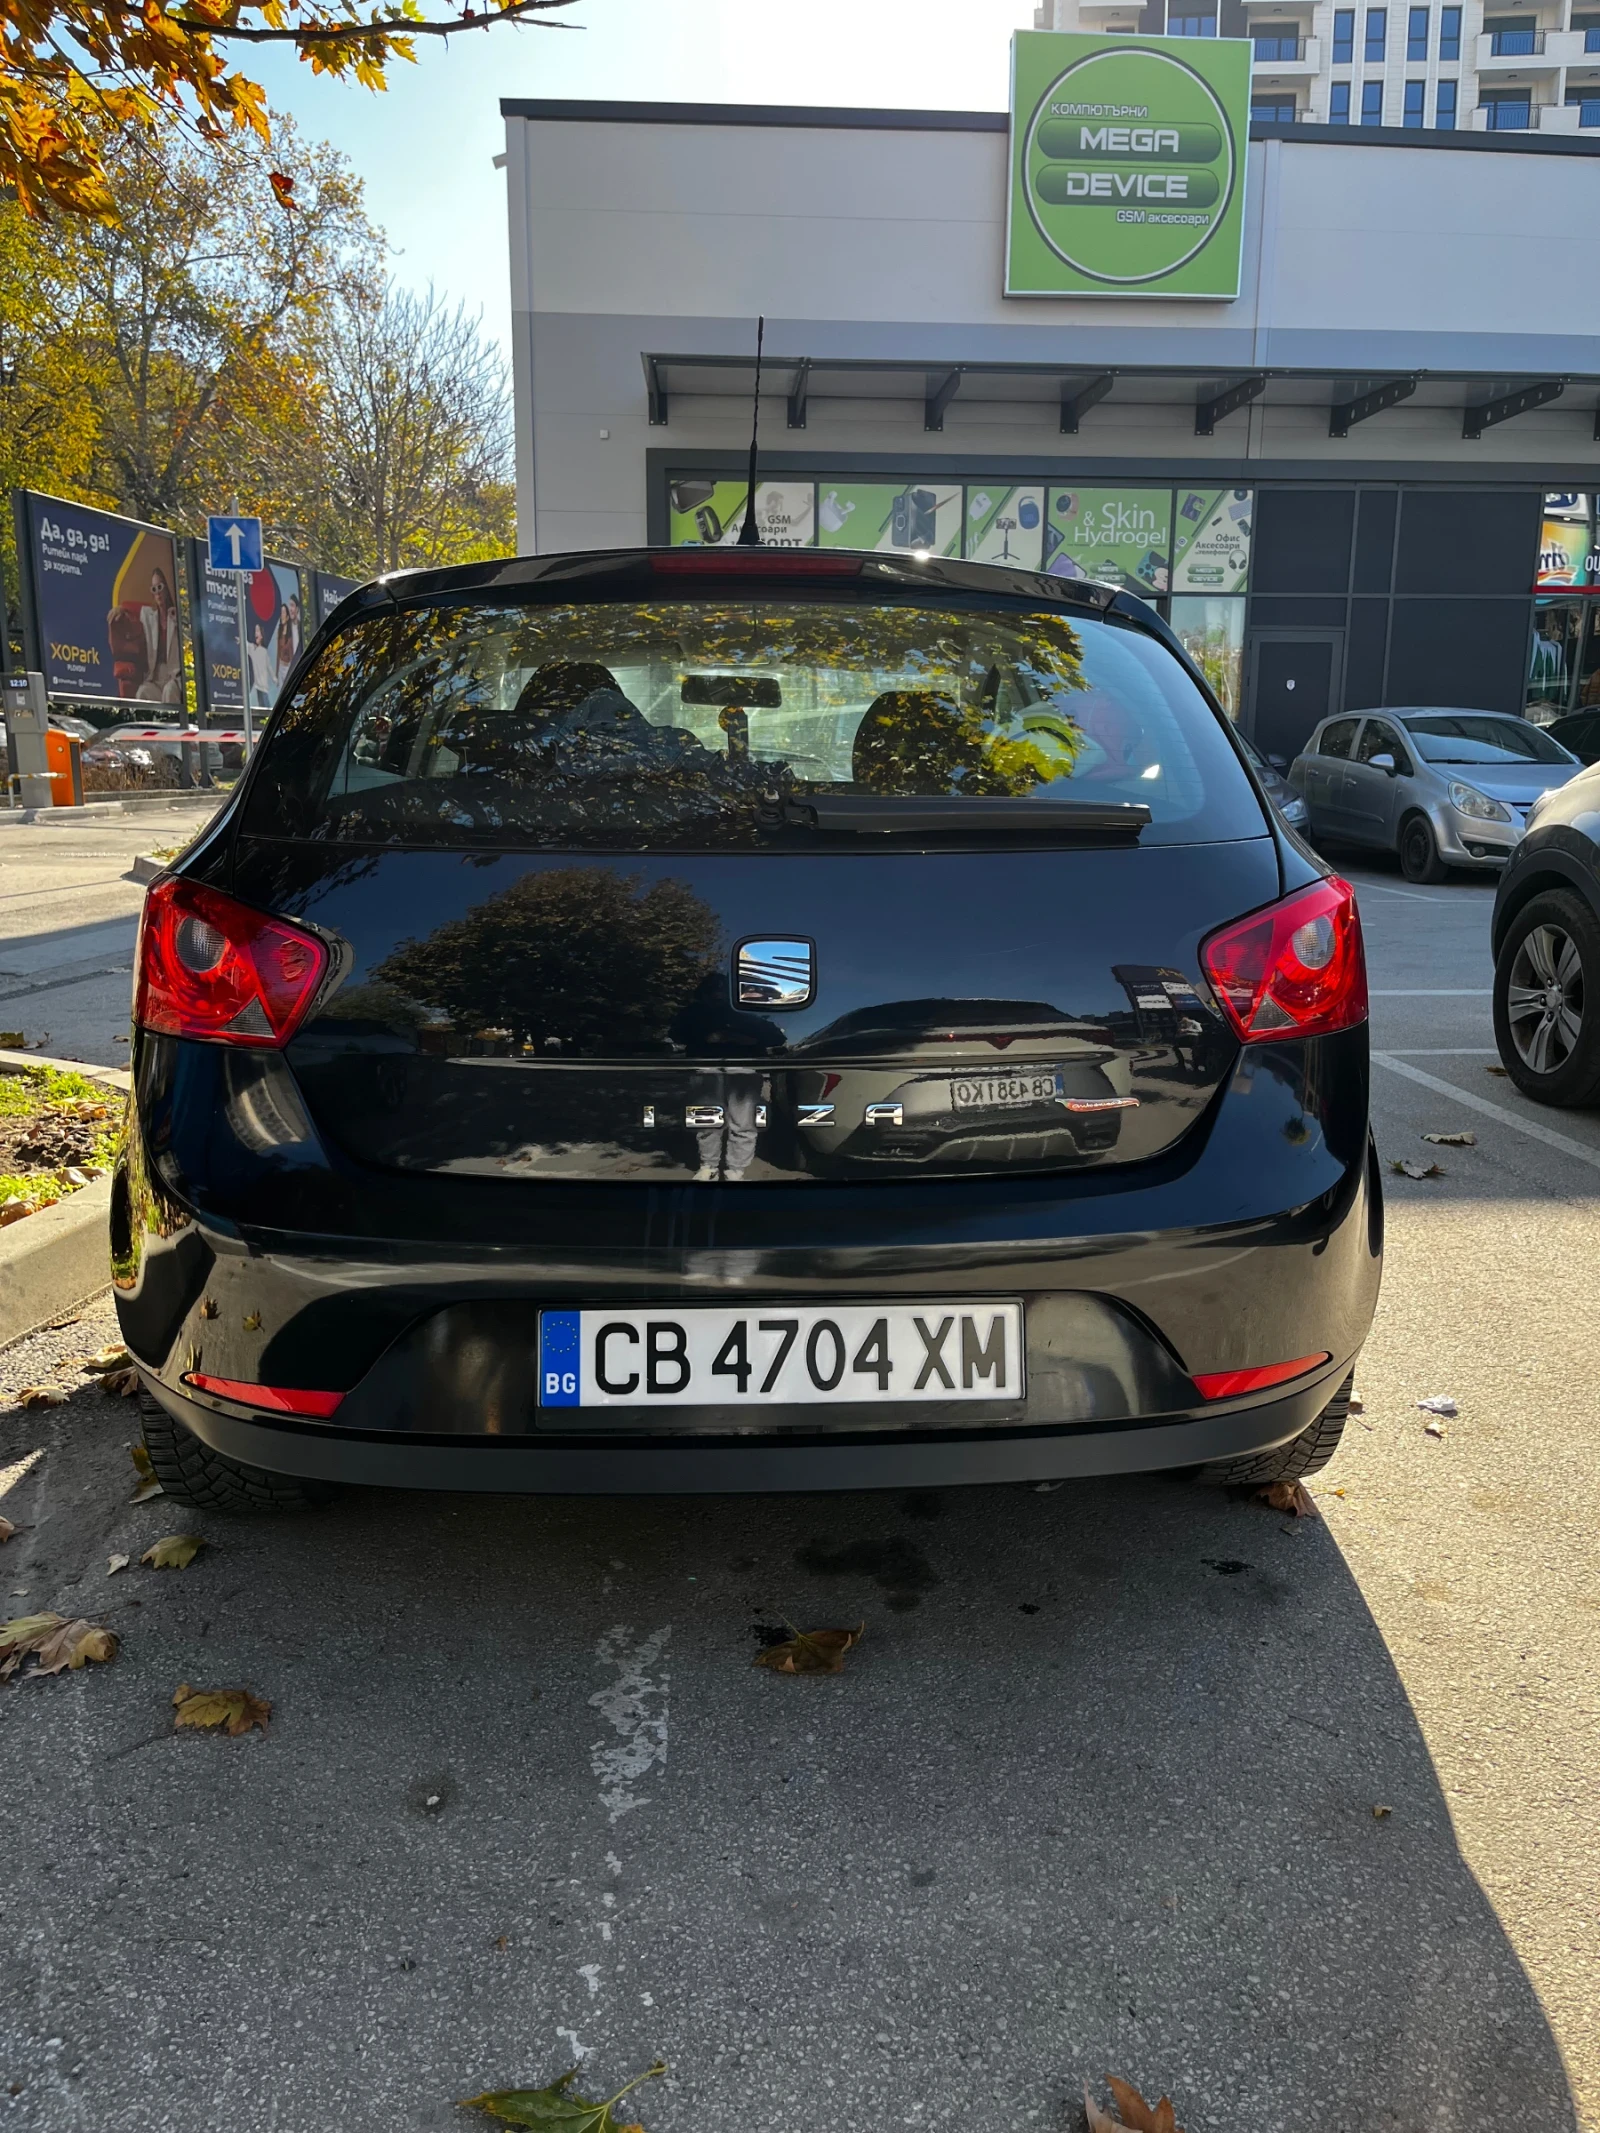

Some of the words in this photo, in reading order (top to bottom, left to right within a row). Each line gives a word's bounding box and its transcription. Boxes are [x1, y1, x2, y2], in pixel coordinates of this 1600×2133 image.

[1051, 103, 1148, 118] КОМПЮТЪРНИ
[1080, 127, 1180, 152] MEGA
[1066, 172, 1189, 199] DEVICE
[1116, 210, 1146, 223] GSM
[1148, 213, 1209, 227] аксесоари
[768, 515, 791, 524] GSM
[1083, 511, 1095, 527] &
[1101, 502, 1155, 529] Skin
[41, 517, 65, 544] Да,
[89, 533, 110, 553] да!
[1074, 526, 1166, 548] Hydrogel
[1195, 541, 1241, 550] Аксесоари
[1215, 533, 1240, 543] Офис
[50, 642, 100, 665] XOPark
[212, 663, 241, 680] XOPar
[643, 1103, 903, 1128] IBIZA
[594, 1321, 692, 1395] CB
[711, 1318, 893, 1393] 4704
[913, 1316, 1006, 1390] XM
[546, 1372, 576, 1394] BG
